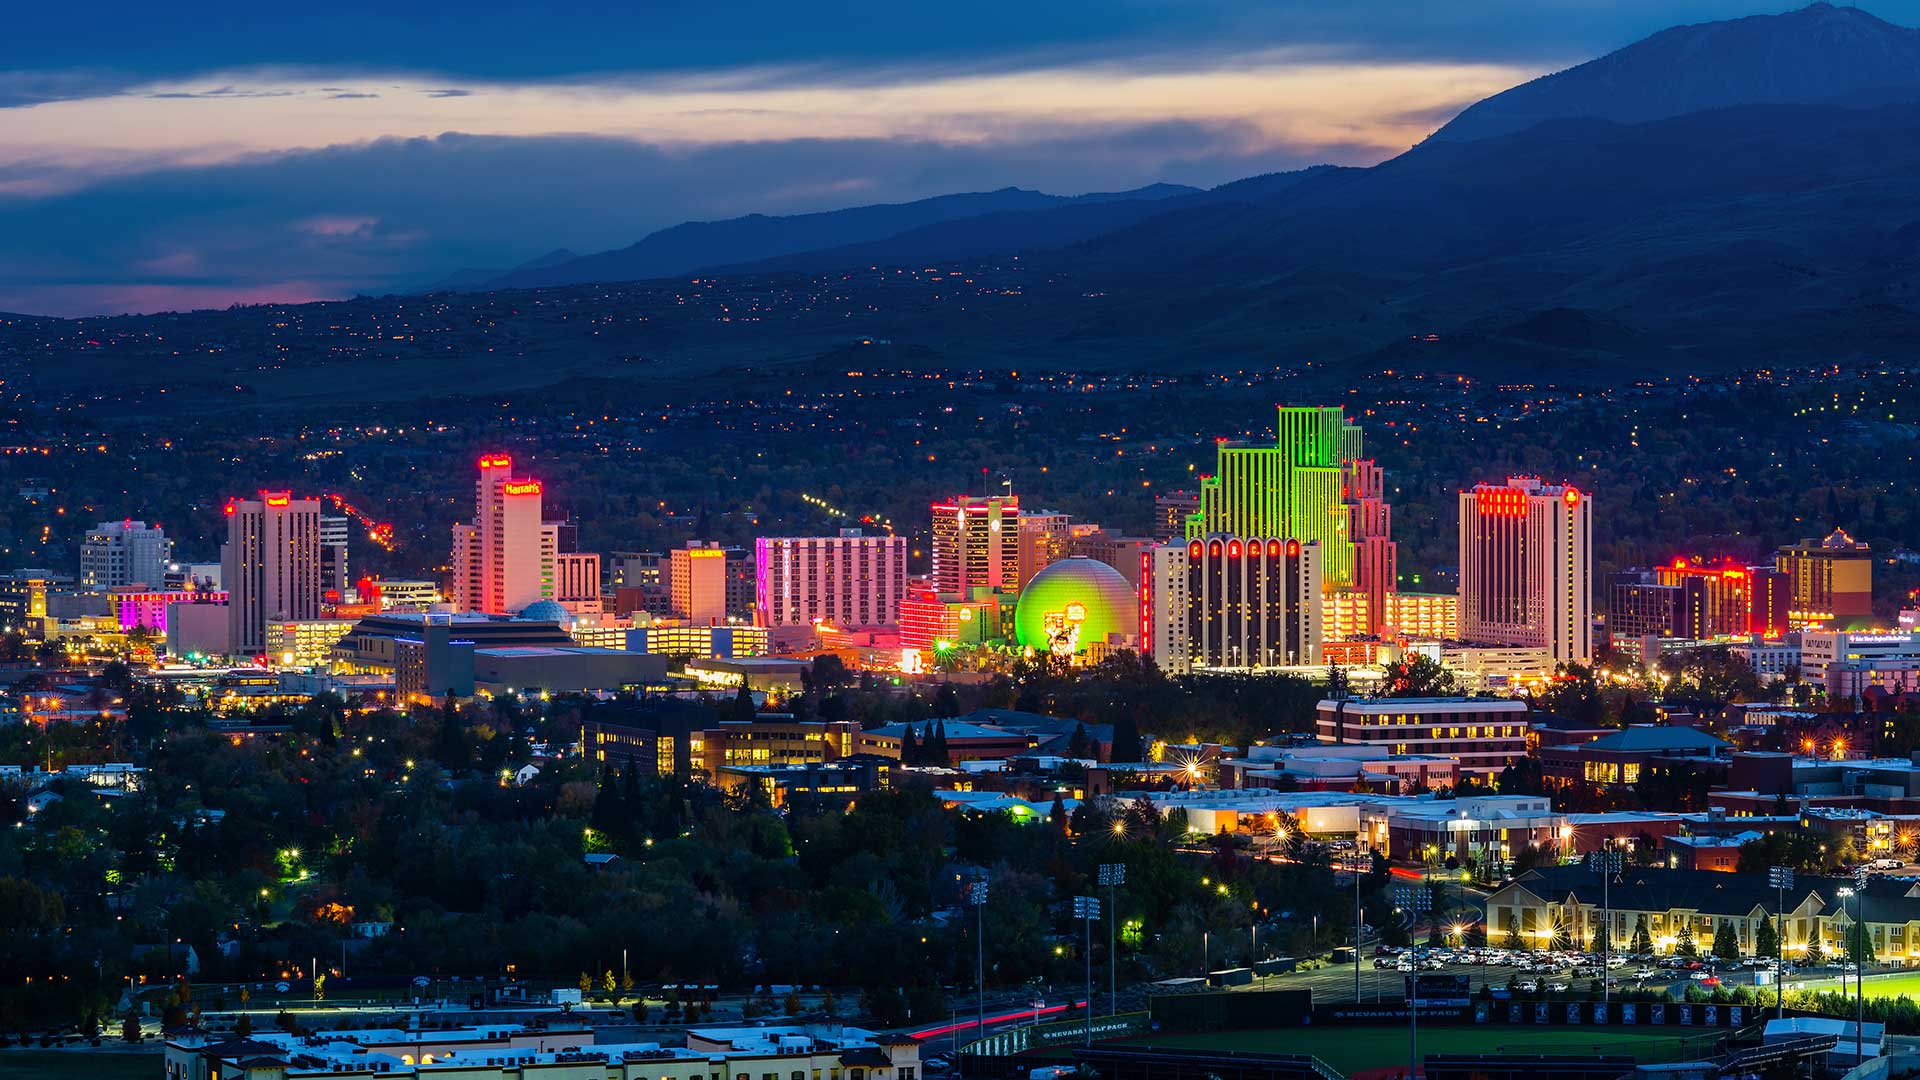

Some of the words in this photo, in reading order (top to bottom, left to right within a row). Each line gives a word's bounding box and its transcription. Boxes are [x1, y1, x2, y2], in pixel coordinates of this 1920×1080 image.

[505, 483, 540, 495] Harrah's
[1193, 545, 1296, 556] CIRCUS
[1051, 1029, 1083, 1038] NEVADA
[1107, 1022, 1128, 1031] PACK
